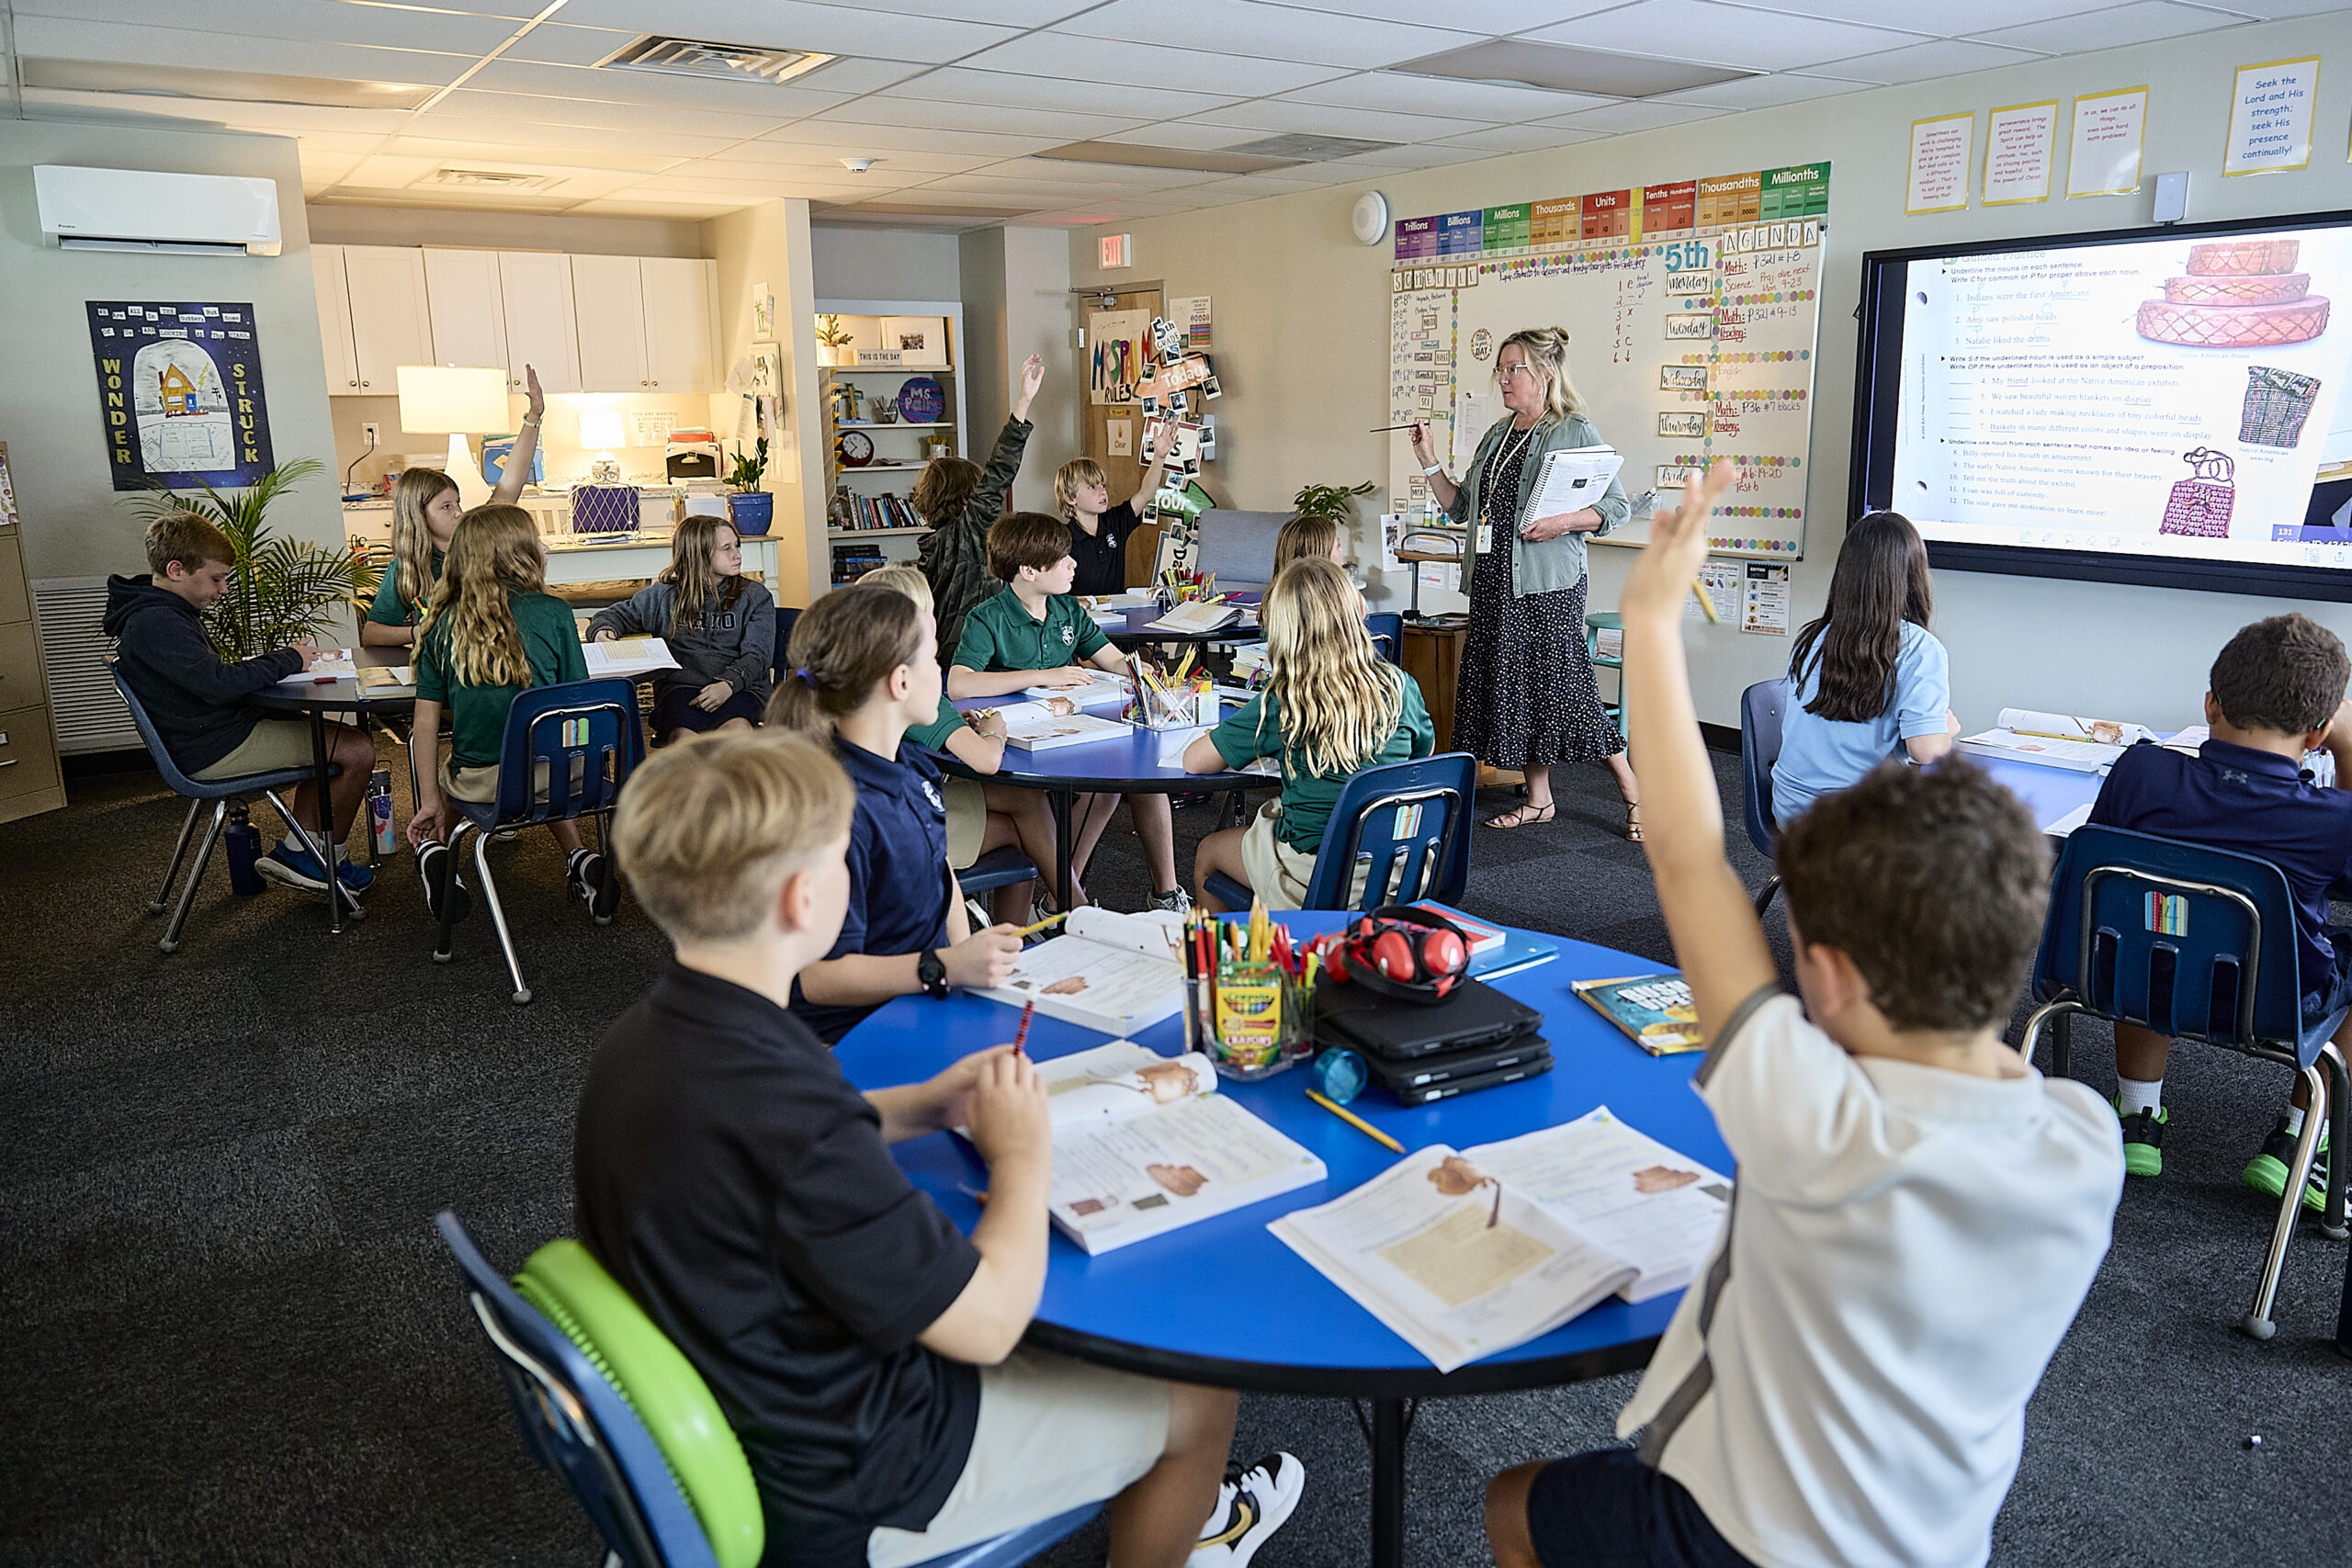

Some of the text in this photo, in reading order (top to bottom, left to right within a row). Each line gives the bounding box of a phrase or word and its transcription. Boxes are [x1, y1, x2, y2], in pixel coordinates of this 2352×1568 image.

[2256, 76, 2297, 89] Seek the
[2245, 89, 2303, 105] Lord and His
[2252, 105, 2293, 117] strength;
[2252, 118, 2290, 130] seek His
[2102, 132, 2127, 141] problems!
[2249, 133, 2289, 146] presence
[2243, 146, 2292, 159] continually!
[1771, 168, 1820, 186] Millionths
[1701, 176, 1760, 194] Thousandths
[1645, 186, 1695, 200] Tenths Hundredths
[1536, 201, 1576, 214] Thousands
[1595, 197, 1616, 209] Units
[1447, 216, 1471, 227] Billions
[1494, 209, 1520, 220] Millions
[1405, 220, 1429, 232] Trillions
[1726, 228, 1815, 252] AGENDA
[1102, 235, 1122, 267] EXIT
[1665, 241, 1709, 272] 5th
[1724, 259, 1747, 274] Math:
[1753, 254, 1776, 269] P321
[1395, 266, 1478, 290] SCHEDULE
[1669, 274, 1710, 291] monday
[1725, 280, 1754, 292] Science:
[1793, 265, 1811, 275] next
[1782, 278, 1803, 288] 9-23
[1615, 310, 1622, 321] 3
[1721, 310, 1746, 323] Math:
[1747, 308, 1768, 322] P321
[1152, 319, 1175, 340] 5th
[1615, 324, 1622, 335] 4
[1720, 328, 1747, 342] Reading:
[1158, 332, 1181, 349] GRADE
[1612, 339, 1620, 349] 5
[1476, 348, 1488, 356] DAY
[1160, 363, 1204, 390] Today
[1663, 371, 1706, 388] wednesday
[1105, 384, 1131, 403] RULES
[102, 358, 132, 464] WONDER
[232, 364, 259, 463] STRUCK
[1715, 402, 1737, 415] Math:
[1661, 416, 1702, 435] thursday
[1714, 419, 1740, 437] Reading:
[1114, 441, 1126, 449] Clear
[1735, 482, 1751, 493] Test
[1225, 1035, 1273, 1047] CRAYONS
